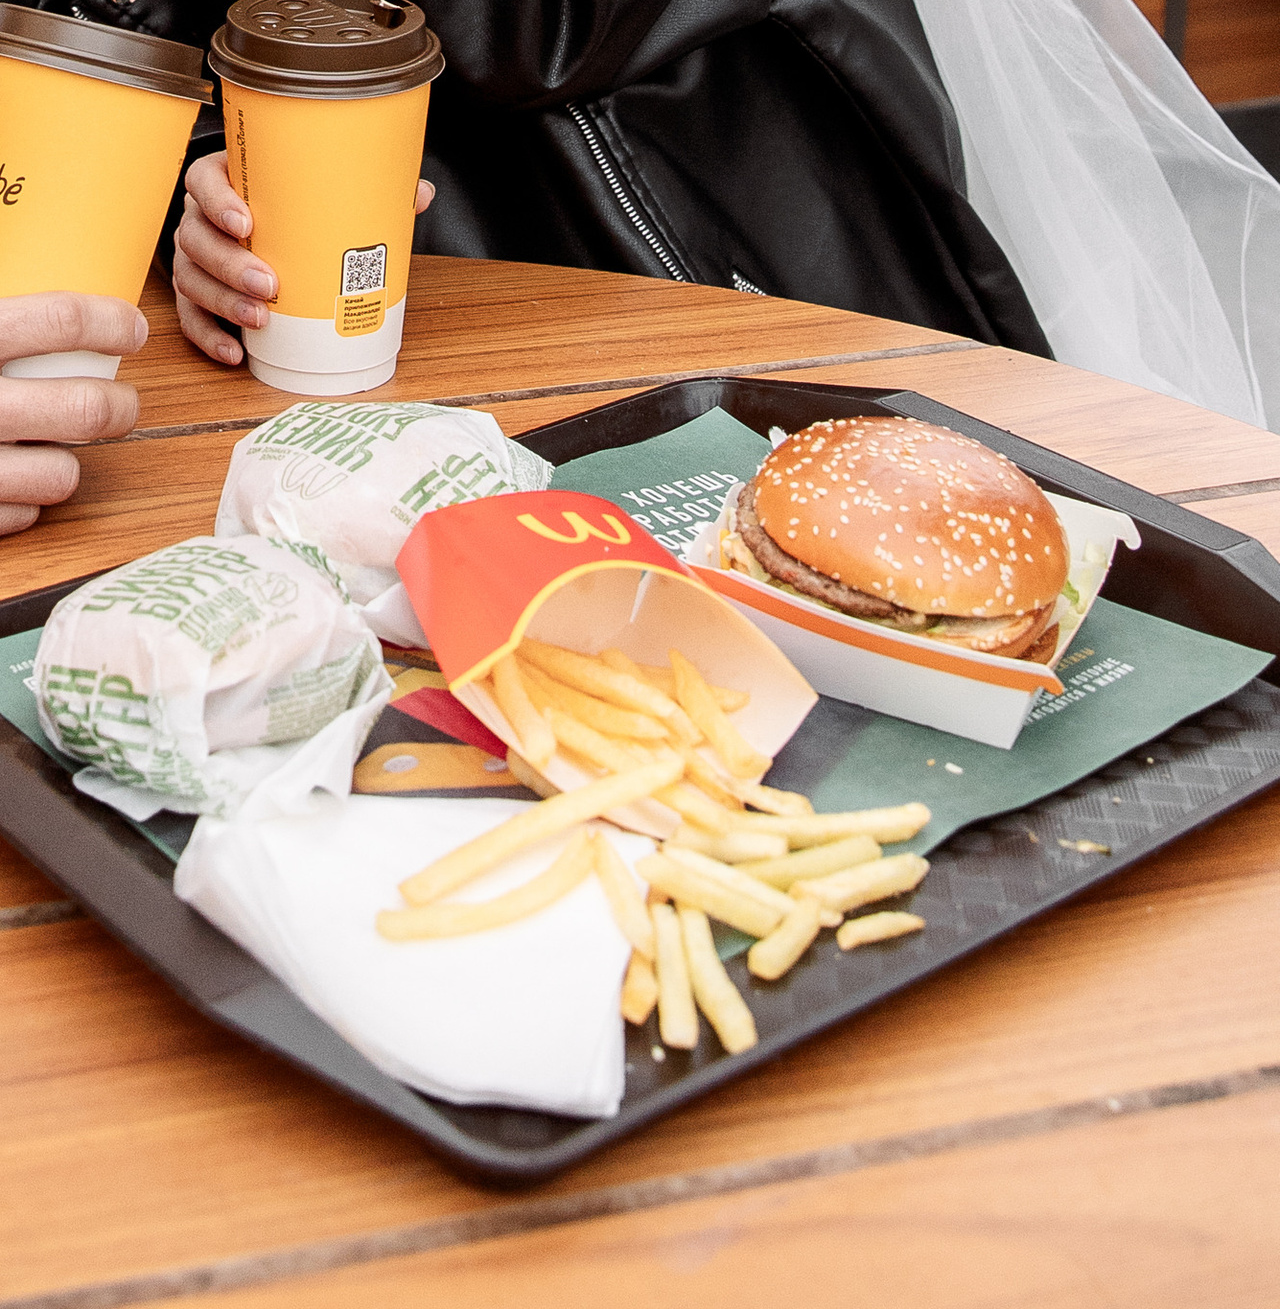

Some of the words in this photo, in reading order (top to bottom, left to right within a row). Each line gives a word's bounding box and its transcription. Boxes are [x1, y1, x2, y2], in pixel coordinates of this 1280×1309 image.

[621, 470, 739, 507] ХОЧЕШЬ
[129, 550, 260, 621] БУРГЕР
[1068, 657, 1121, 686] КОТОРЫЕ
[1092, 663, 1135, 687] ЖИЗНИ
